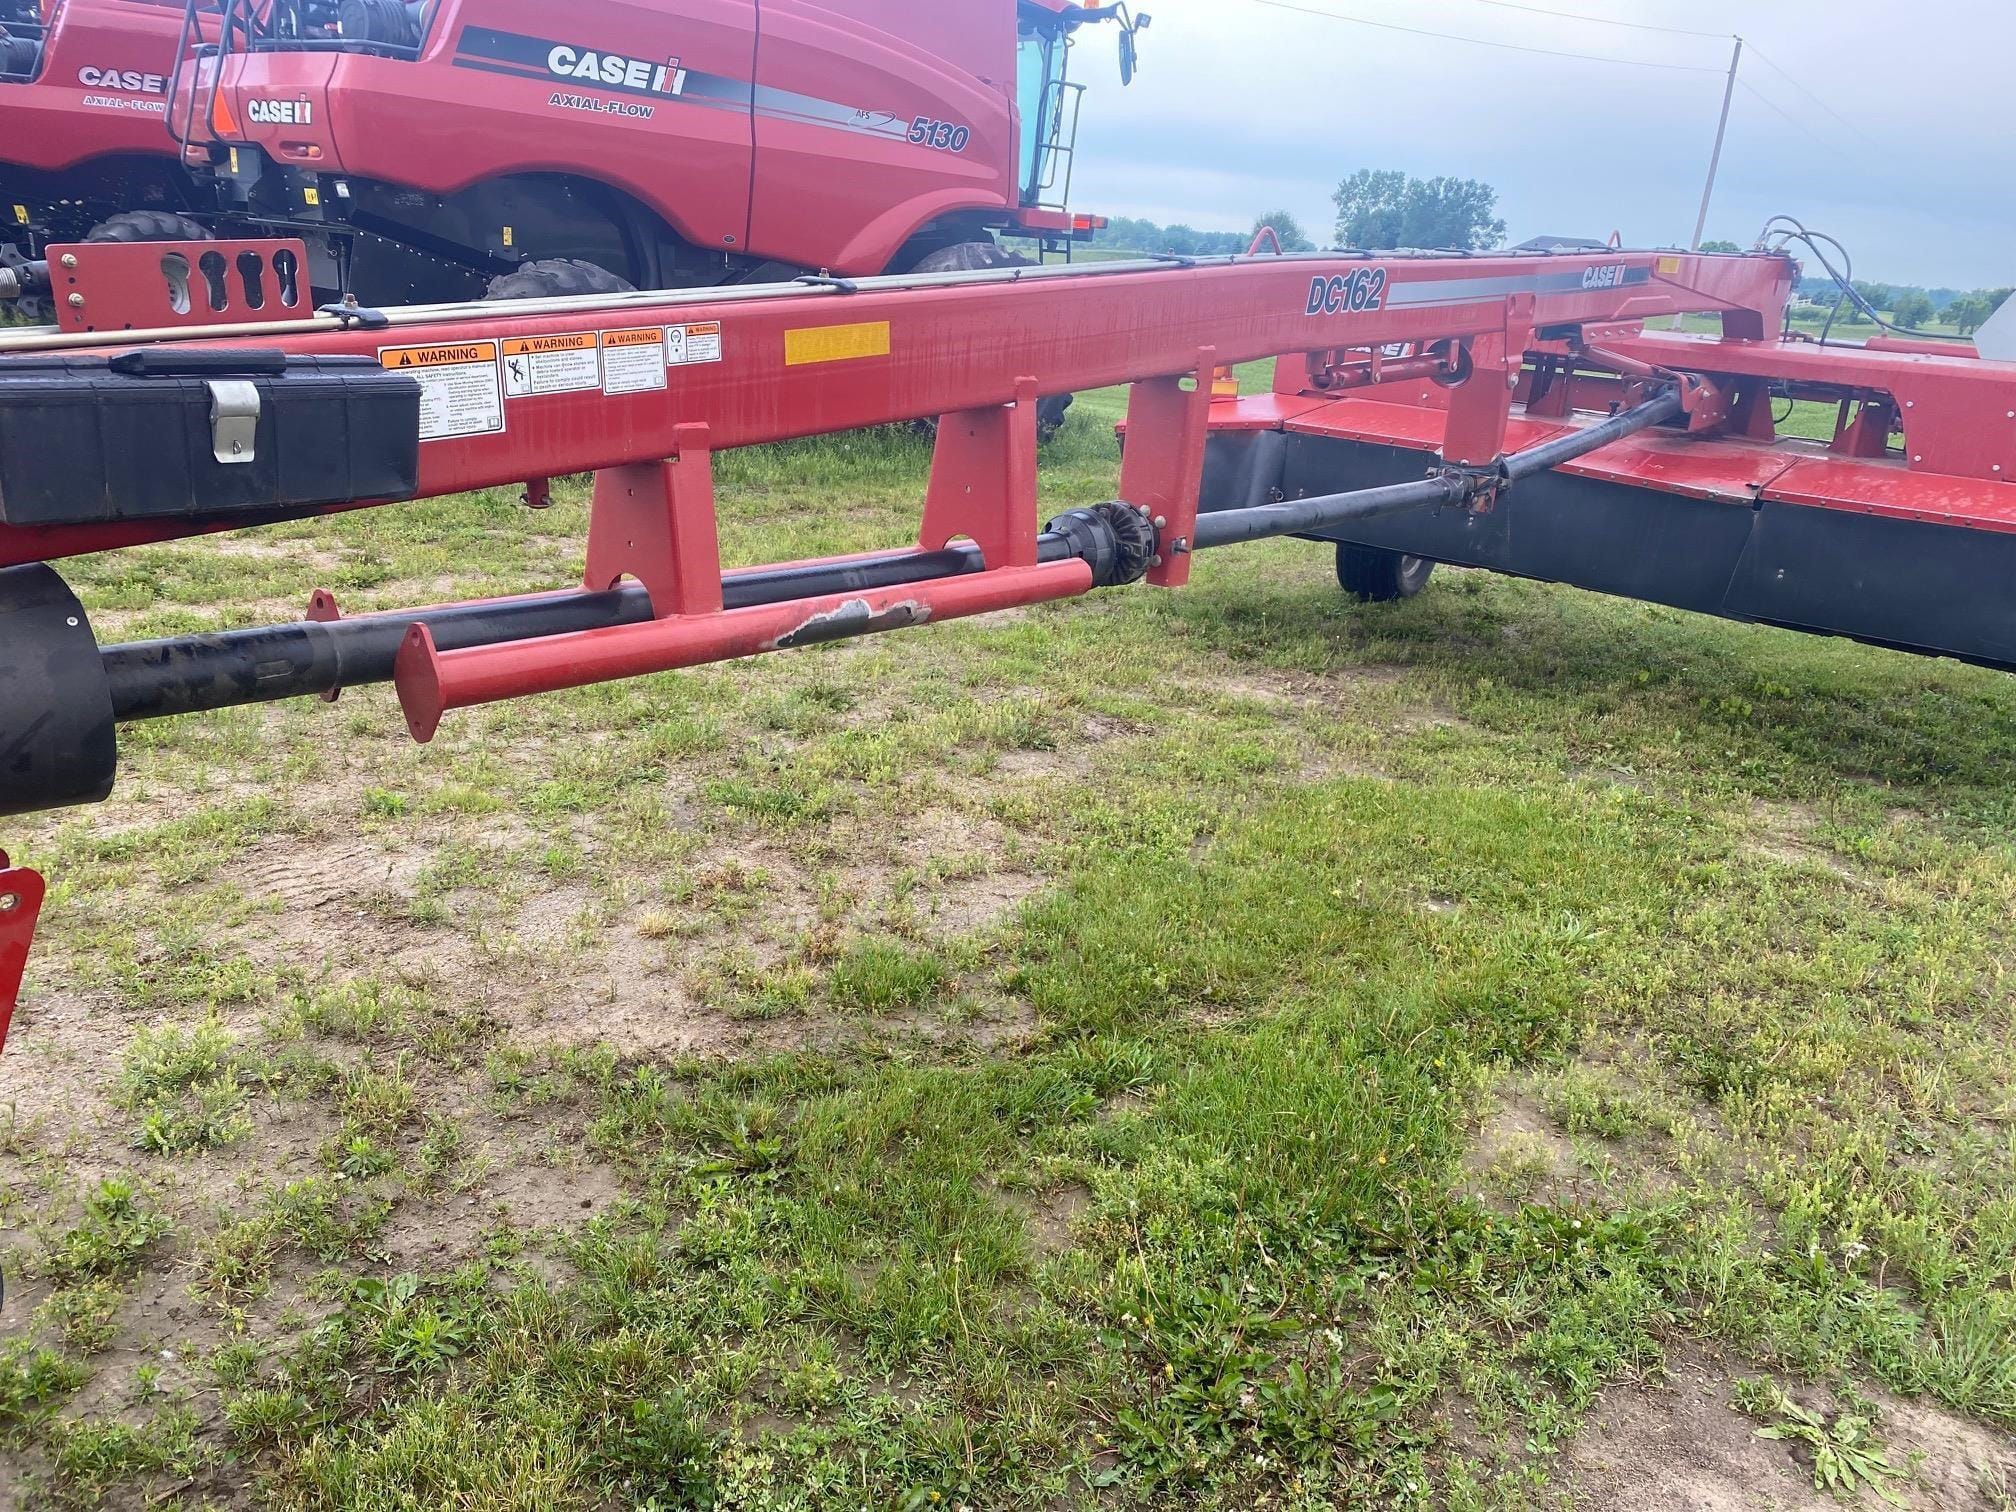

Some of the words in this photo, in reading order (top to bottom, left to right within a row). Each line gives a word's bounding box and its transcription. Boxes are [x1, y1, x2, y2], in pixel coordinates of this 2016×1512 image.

[78, 66, 162, 93] CASE
[548, 46, 652, 89] CASE
[249, 100, 293, 123] CASE
[549, 93, 654, 119] AXIAL-FLOW
[908, 116, 969, 152] 5130
[1305, 267, 1387, 315] DC162
[533, 336, 583, 350] WARNING
[617, 332, 657, 343] WARNING
[417, 347, 478, 363] WARNING
